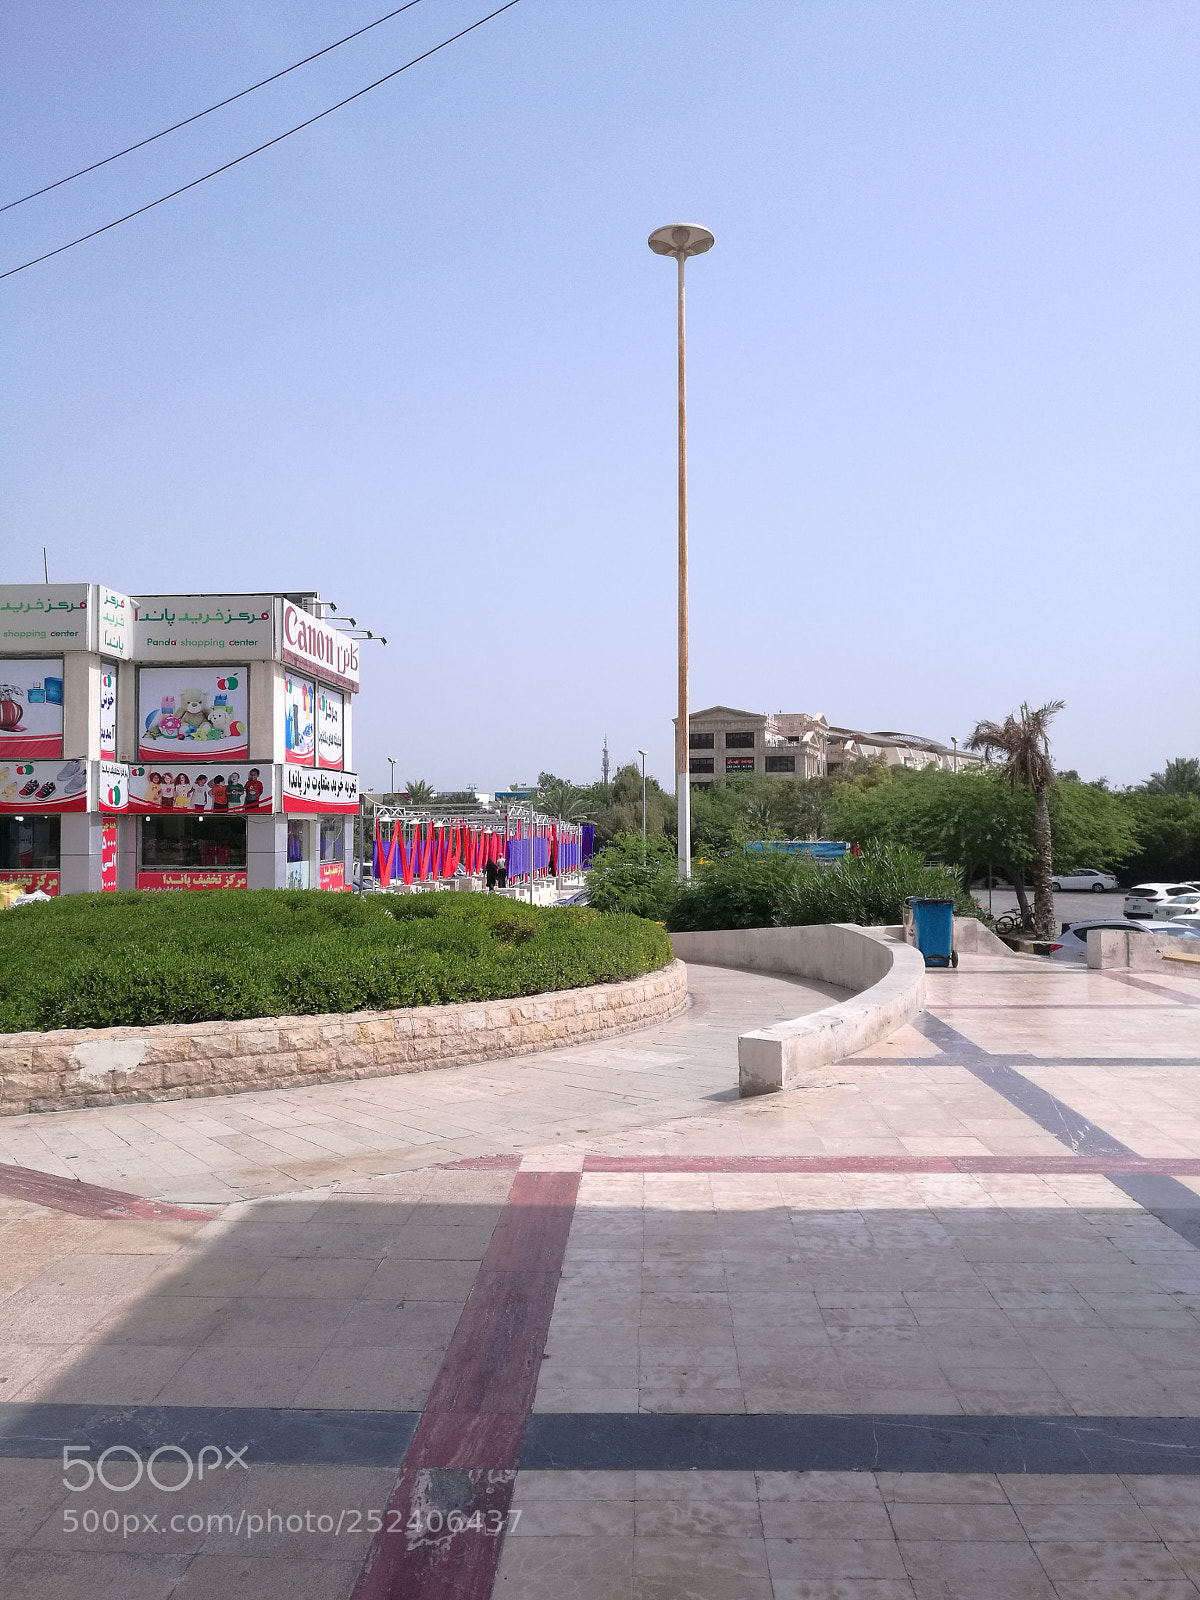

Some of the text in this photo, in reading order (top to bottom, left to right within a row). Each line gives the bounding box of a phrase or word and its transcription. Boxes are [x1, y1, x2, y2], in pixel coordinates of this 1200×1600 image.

[1, 598, 87, 613] مرکز خرید
[104, 589, 125, 609] مرکز
[103, 612, 125, 627] خرید
[134, 606, 270, 626] مرکز خرید پاندا
[3, 630, 46, 639] shopping
[104, 630, 124, 655] پاندا
[147, 638, 177, 646] Panda
[181, 638, 225, 648] shopping
[285, 606, 333, 665] Canon
[288, 769, 357, 798] تجربه خرید متفاوت در پاندا
[34, 873, 58, 890] مرکز
[163, 873, 246, 888] مرکز تخفیف پاندا
